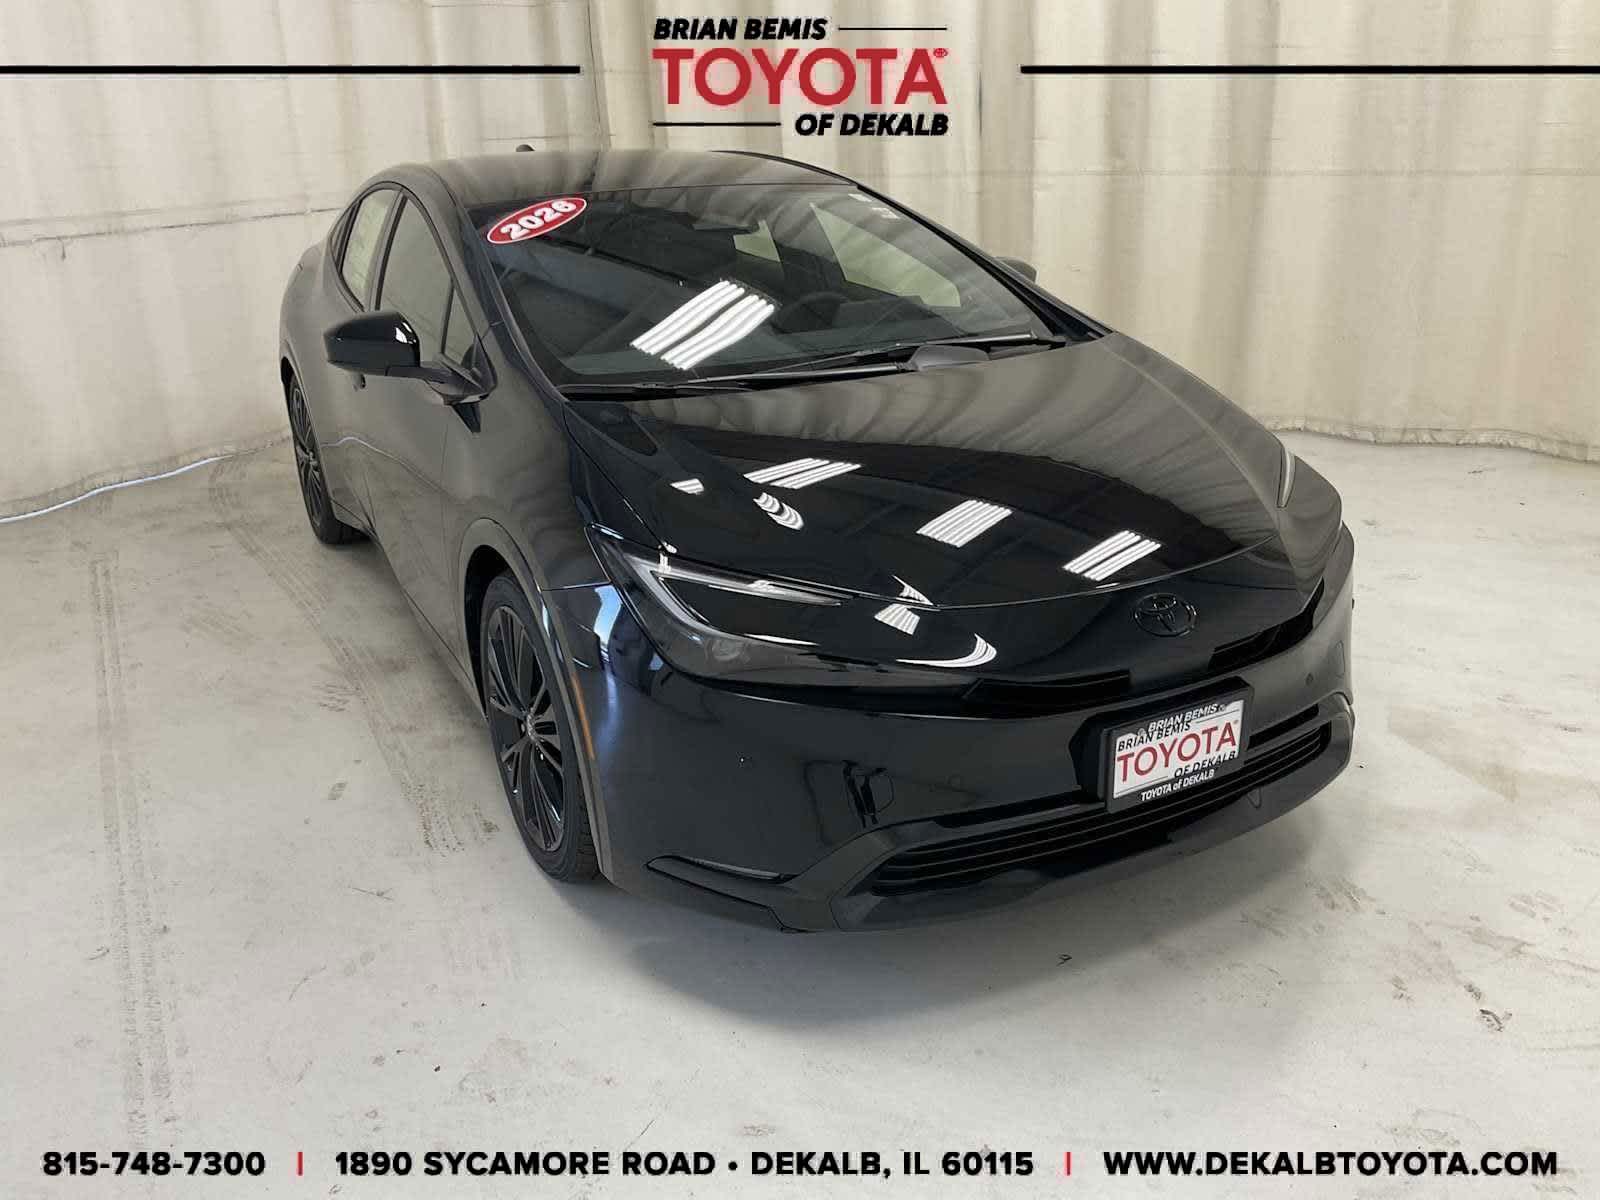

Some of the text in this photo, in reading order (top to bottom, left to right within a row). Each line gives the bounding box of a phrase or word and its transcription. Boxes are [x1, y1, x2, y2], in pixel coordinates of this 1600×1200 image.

[501, 200, 577, 240] 2026
[1148, 703, 1219, 733] BRIAN BEMIS
[1116, 721, 1237, 783] TOYOTA
[1118, 730, 1155, 752] BRIAN
[1141, 768, 1215, 802] TOYOTA of DEKALB
